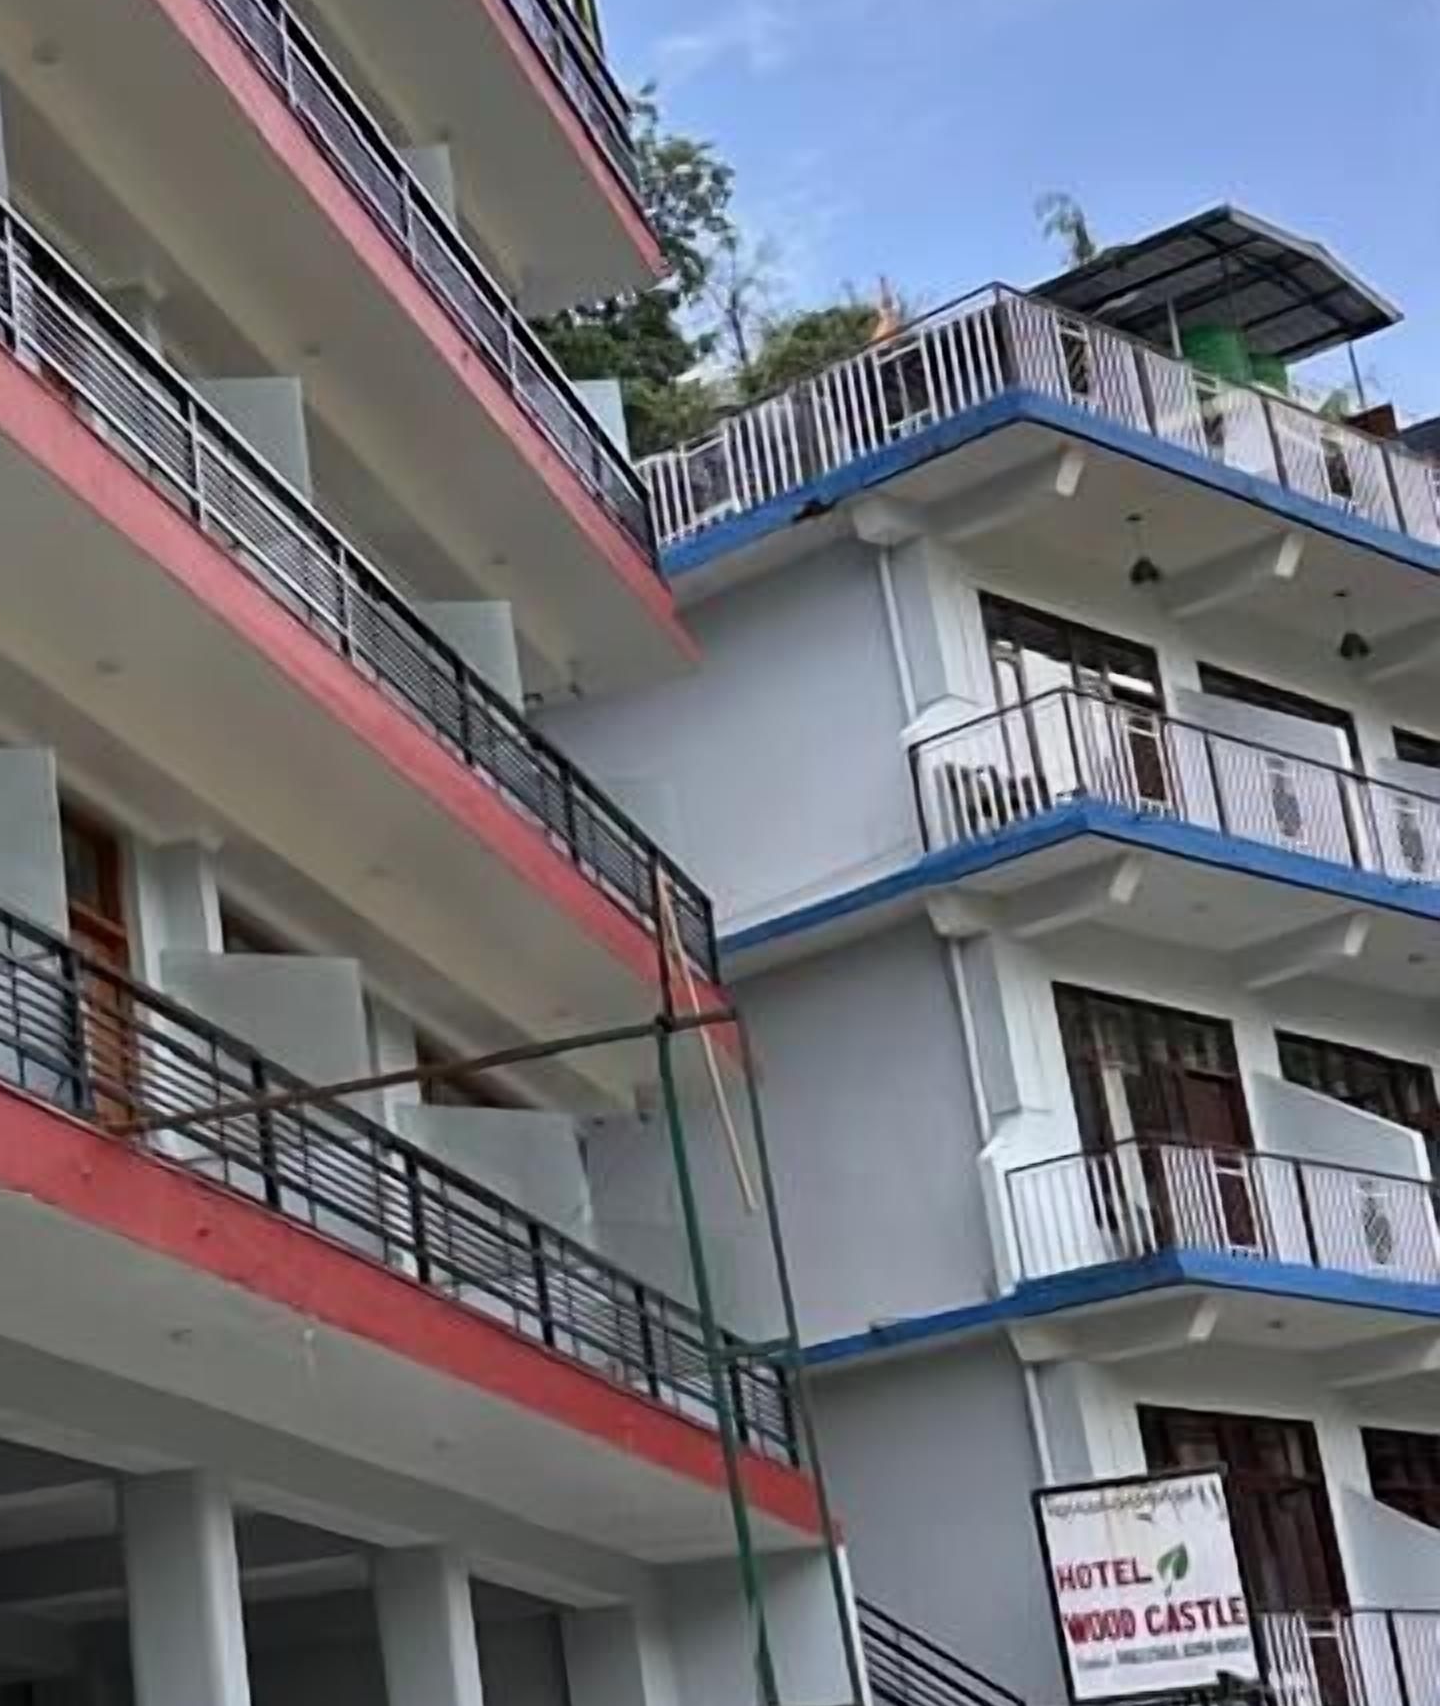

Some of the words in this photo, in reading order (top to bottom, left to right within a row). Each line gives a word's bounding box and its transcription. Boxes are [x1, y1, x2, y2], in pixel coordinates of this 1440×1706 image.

[1056, 1557, 1153, 1591] HOTEL
[1063, 1607, 1136, 1644] WOOD
[1144, 1596, 1247, 1637] CASTLE
